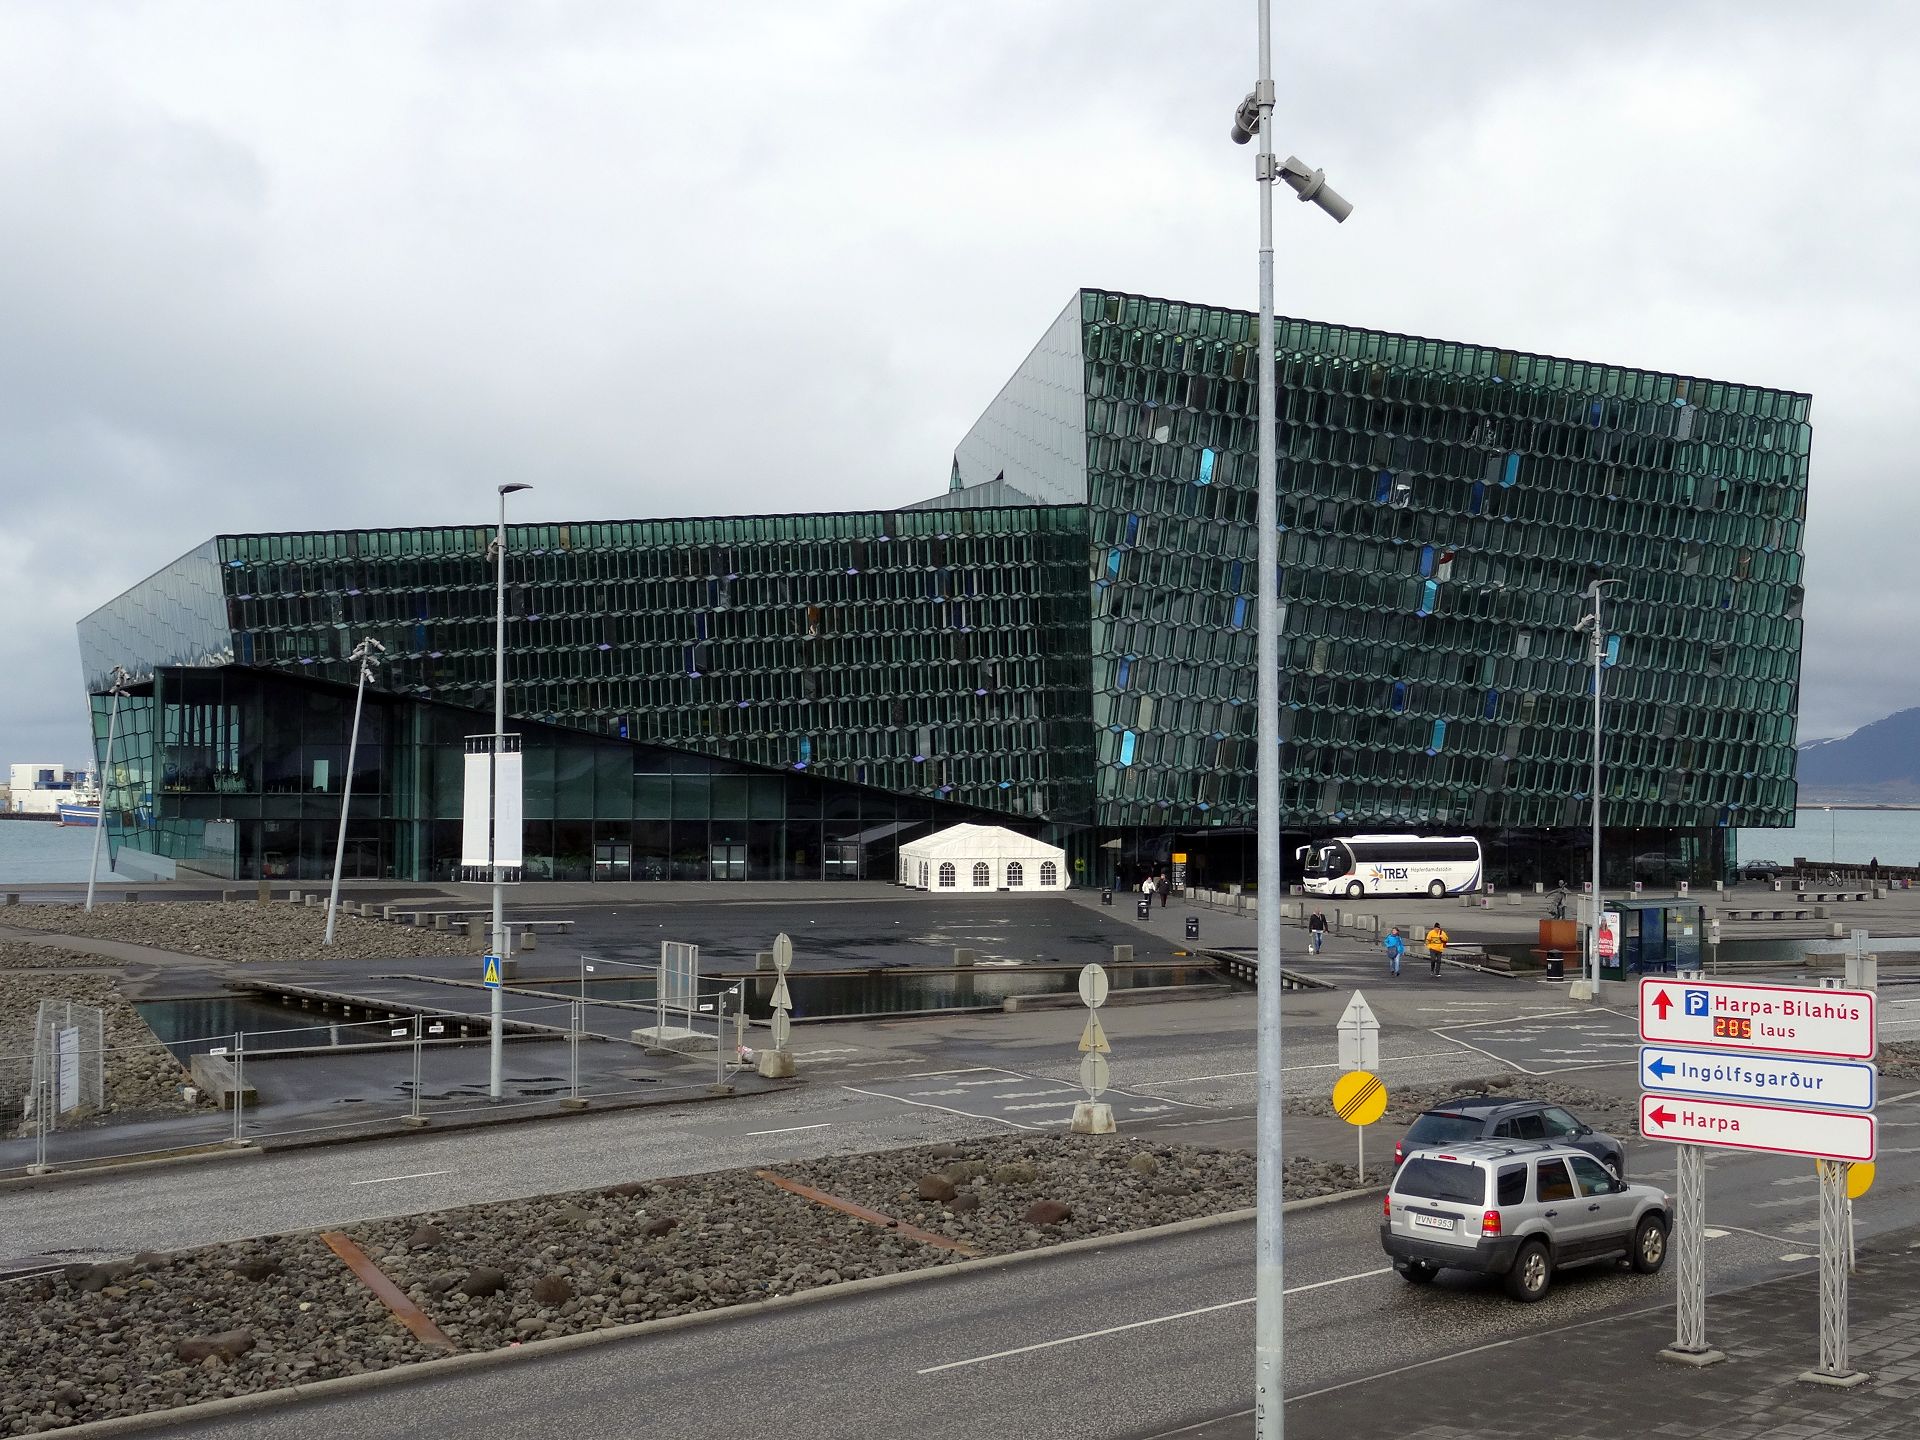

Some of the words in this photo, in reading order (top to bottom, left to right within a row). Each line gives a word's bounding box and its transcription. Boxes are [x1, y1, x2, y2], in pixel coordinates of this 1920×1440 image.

[1383, 868, 1408, 879] TREX
[1690, 997, 1703, 1015] P
[1715, 995, 1860, 1020] Harpa-Bílahús
[1716, 1018, 1752, 1038] 285
[1761, 1023, 1796, 1038] laus
[1682, 1062, 1824, 1089] Ingólfsgarður
[1683, 1111, 1740, 1132] Harpa
